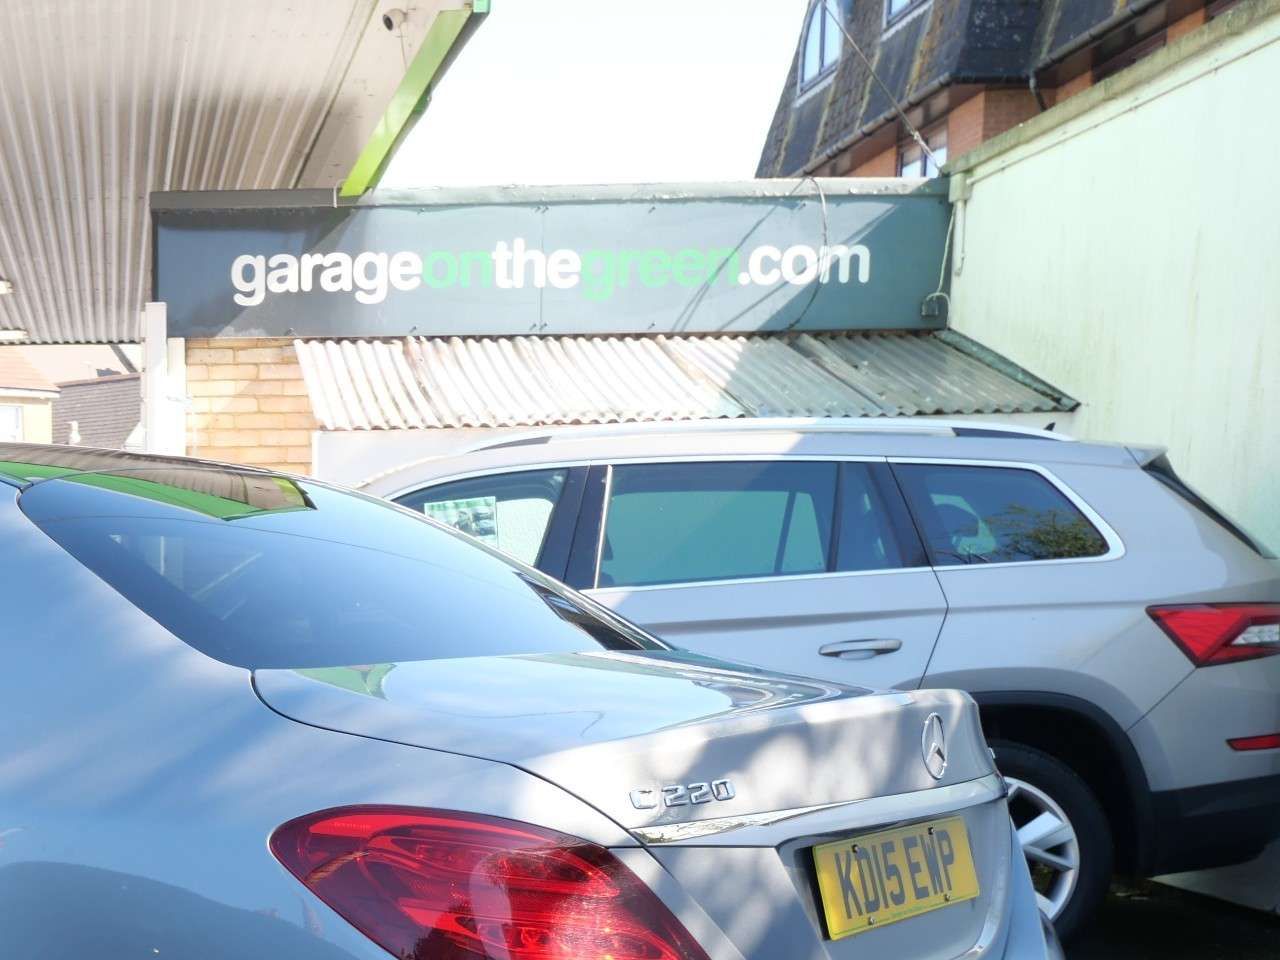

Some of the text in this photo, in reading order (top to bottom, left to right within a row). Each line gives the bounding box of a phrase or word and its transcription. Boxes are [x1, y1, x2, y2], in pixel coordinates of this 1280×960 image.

[230, 237, 871, 306] garageonthegreen.com
[834, 829, 955, 919] KD15 EWP
